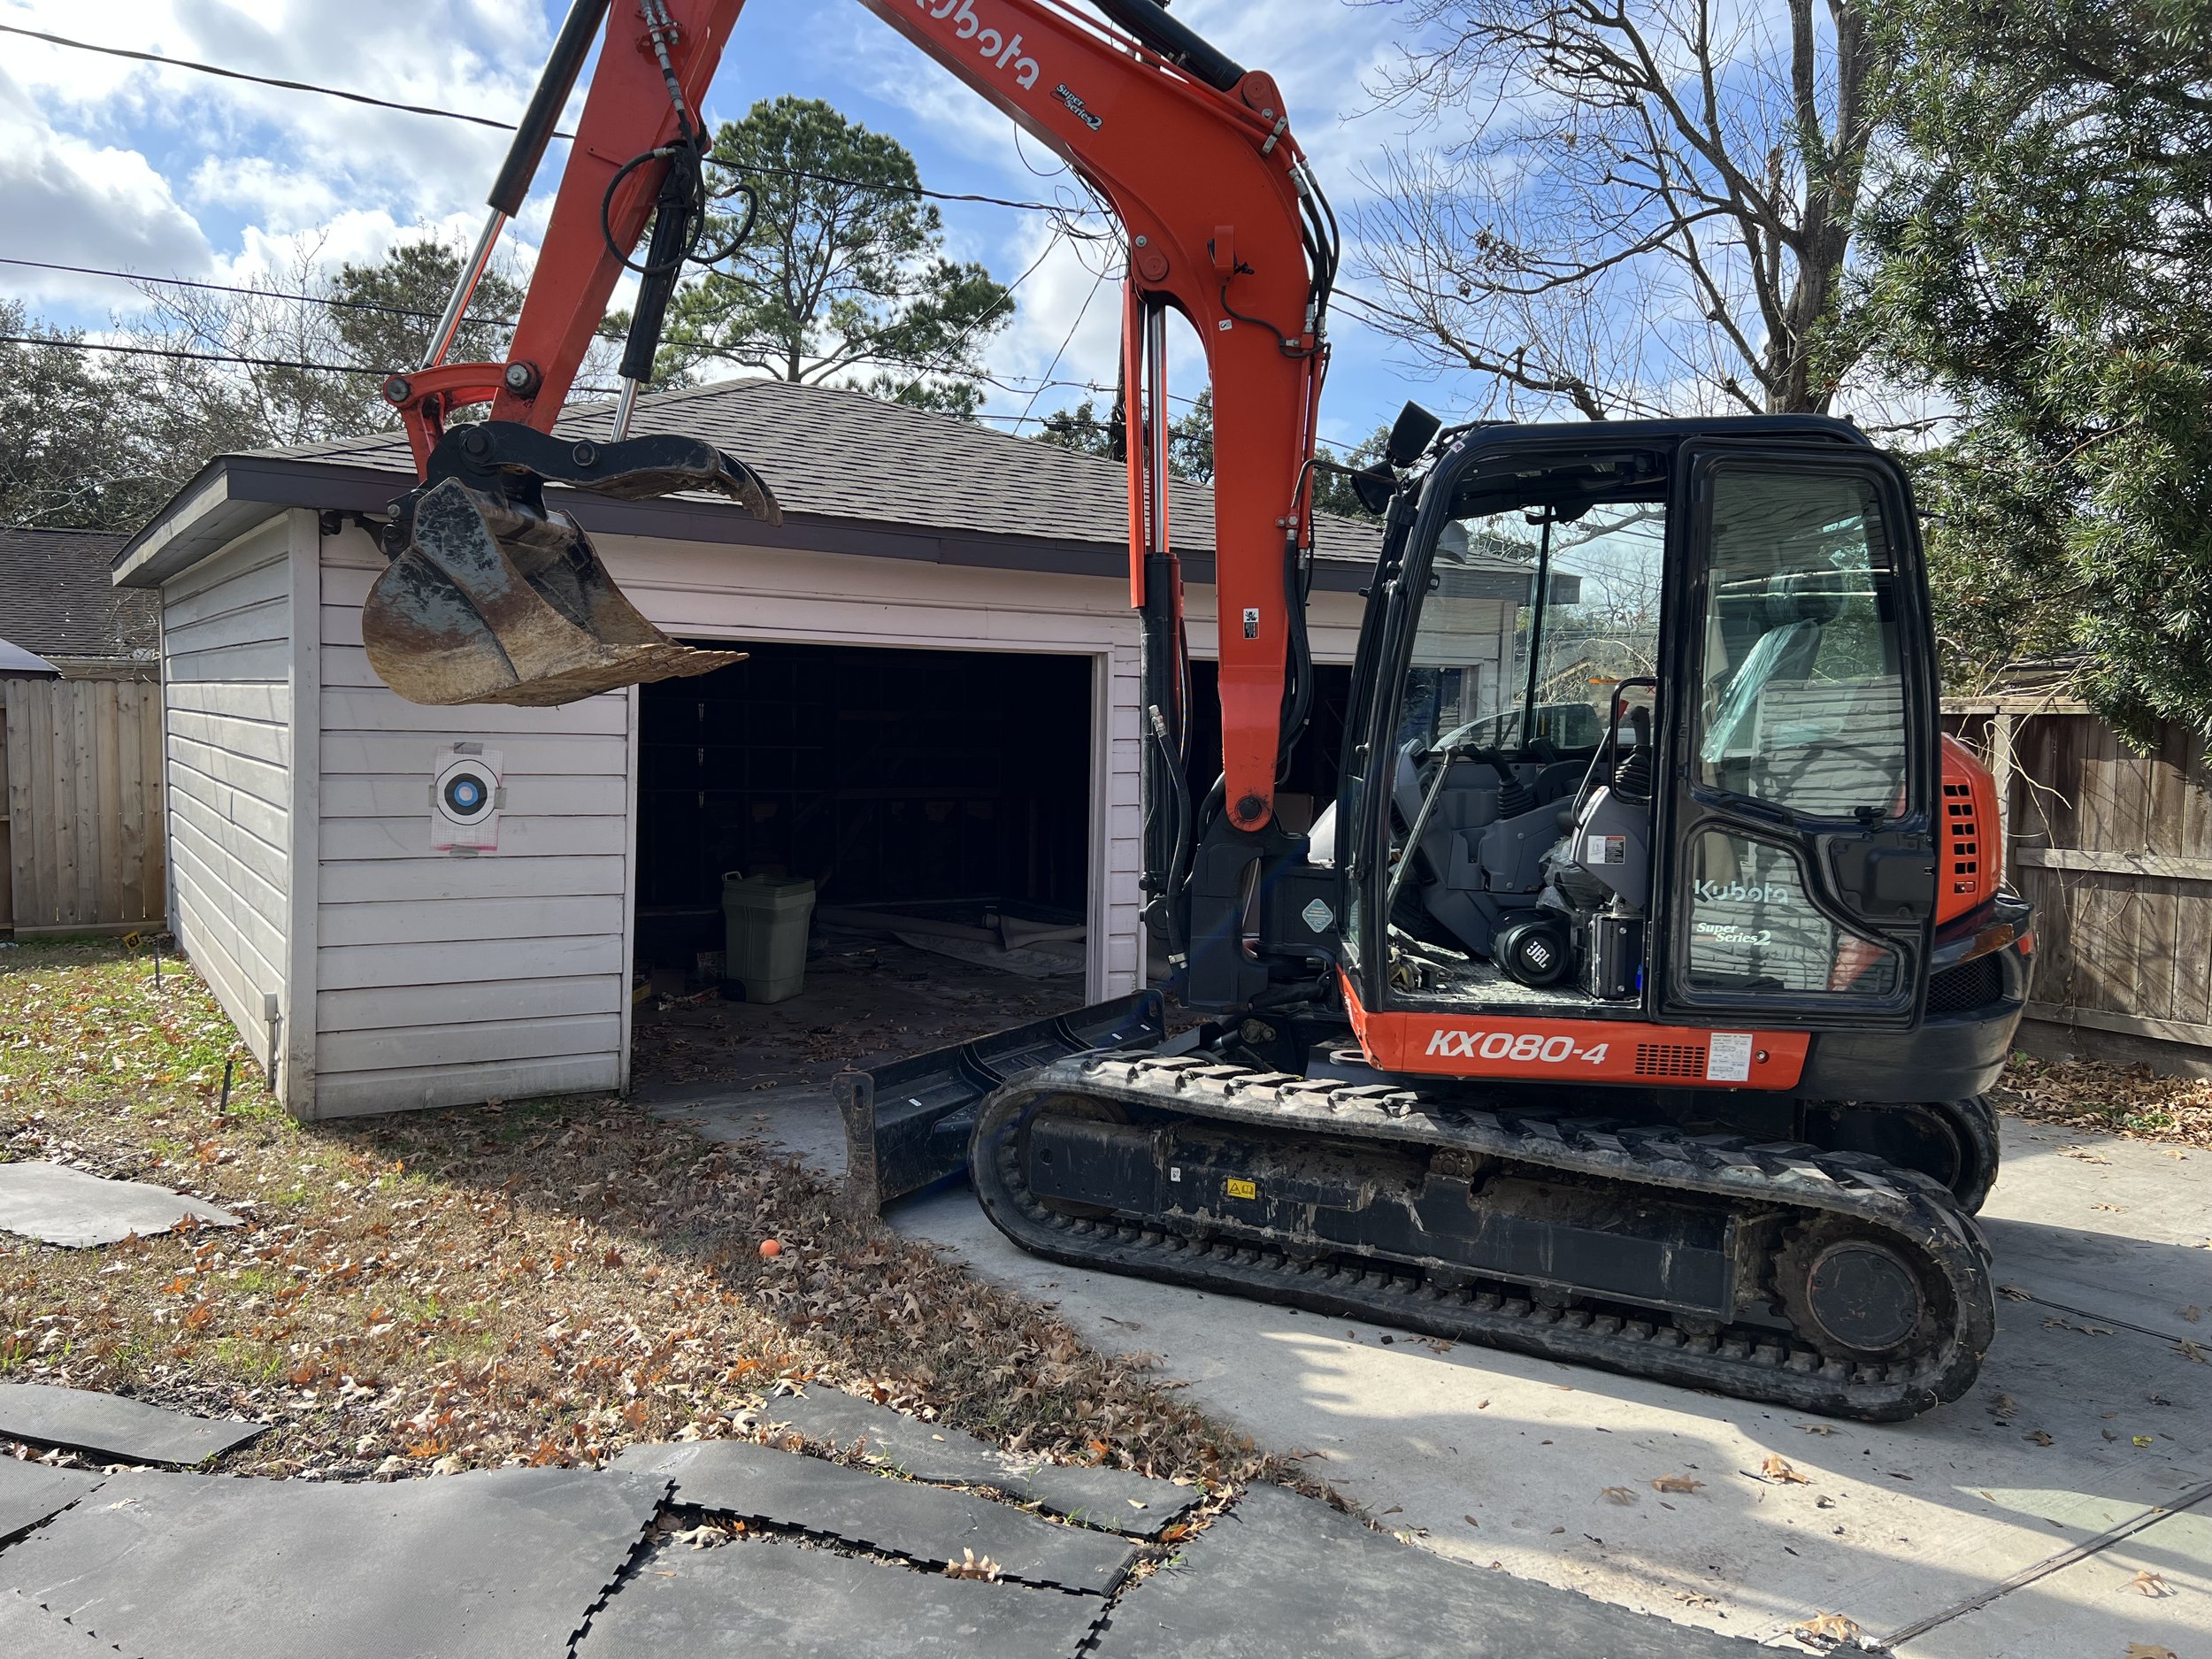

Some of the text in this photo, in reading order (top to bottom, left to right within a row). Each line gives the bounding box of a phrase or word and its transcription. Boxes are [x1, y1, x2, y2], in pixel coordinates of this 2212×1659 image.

[917, 0, 1040, 90] ubota
[1056, 84, 1085, 107] Super
[1694, 879, 1788, 903] Kubota
[1696, 922, 1739, 934] Super
[1526, 941, 1550, 969] JBL
[1425, 1029, 1609, 1064] KX080-4
